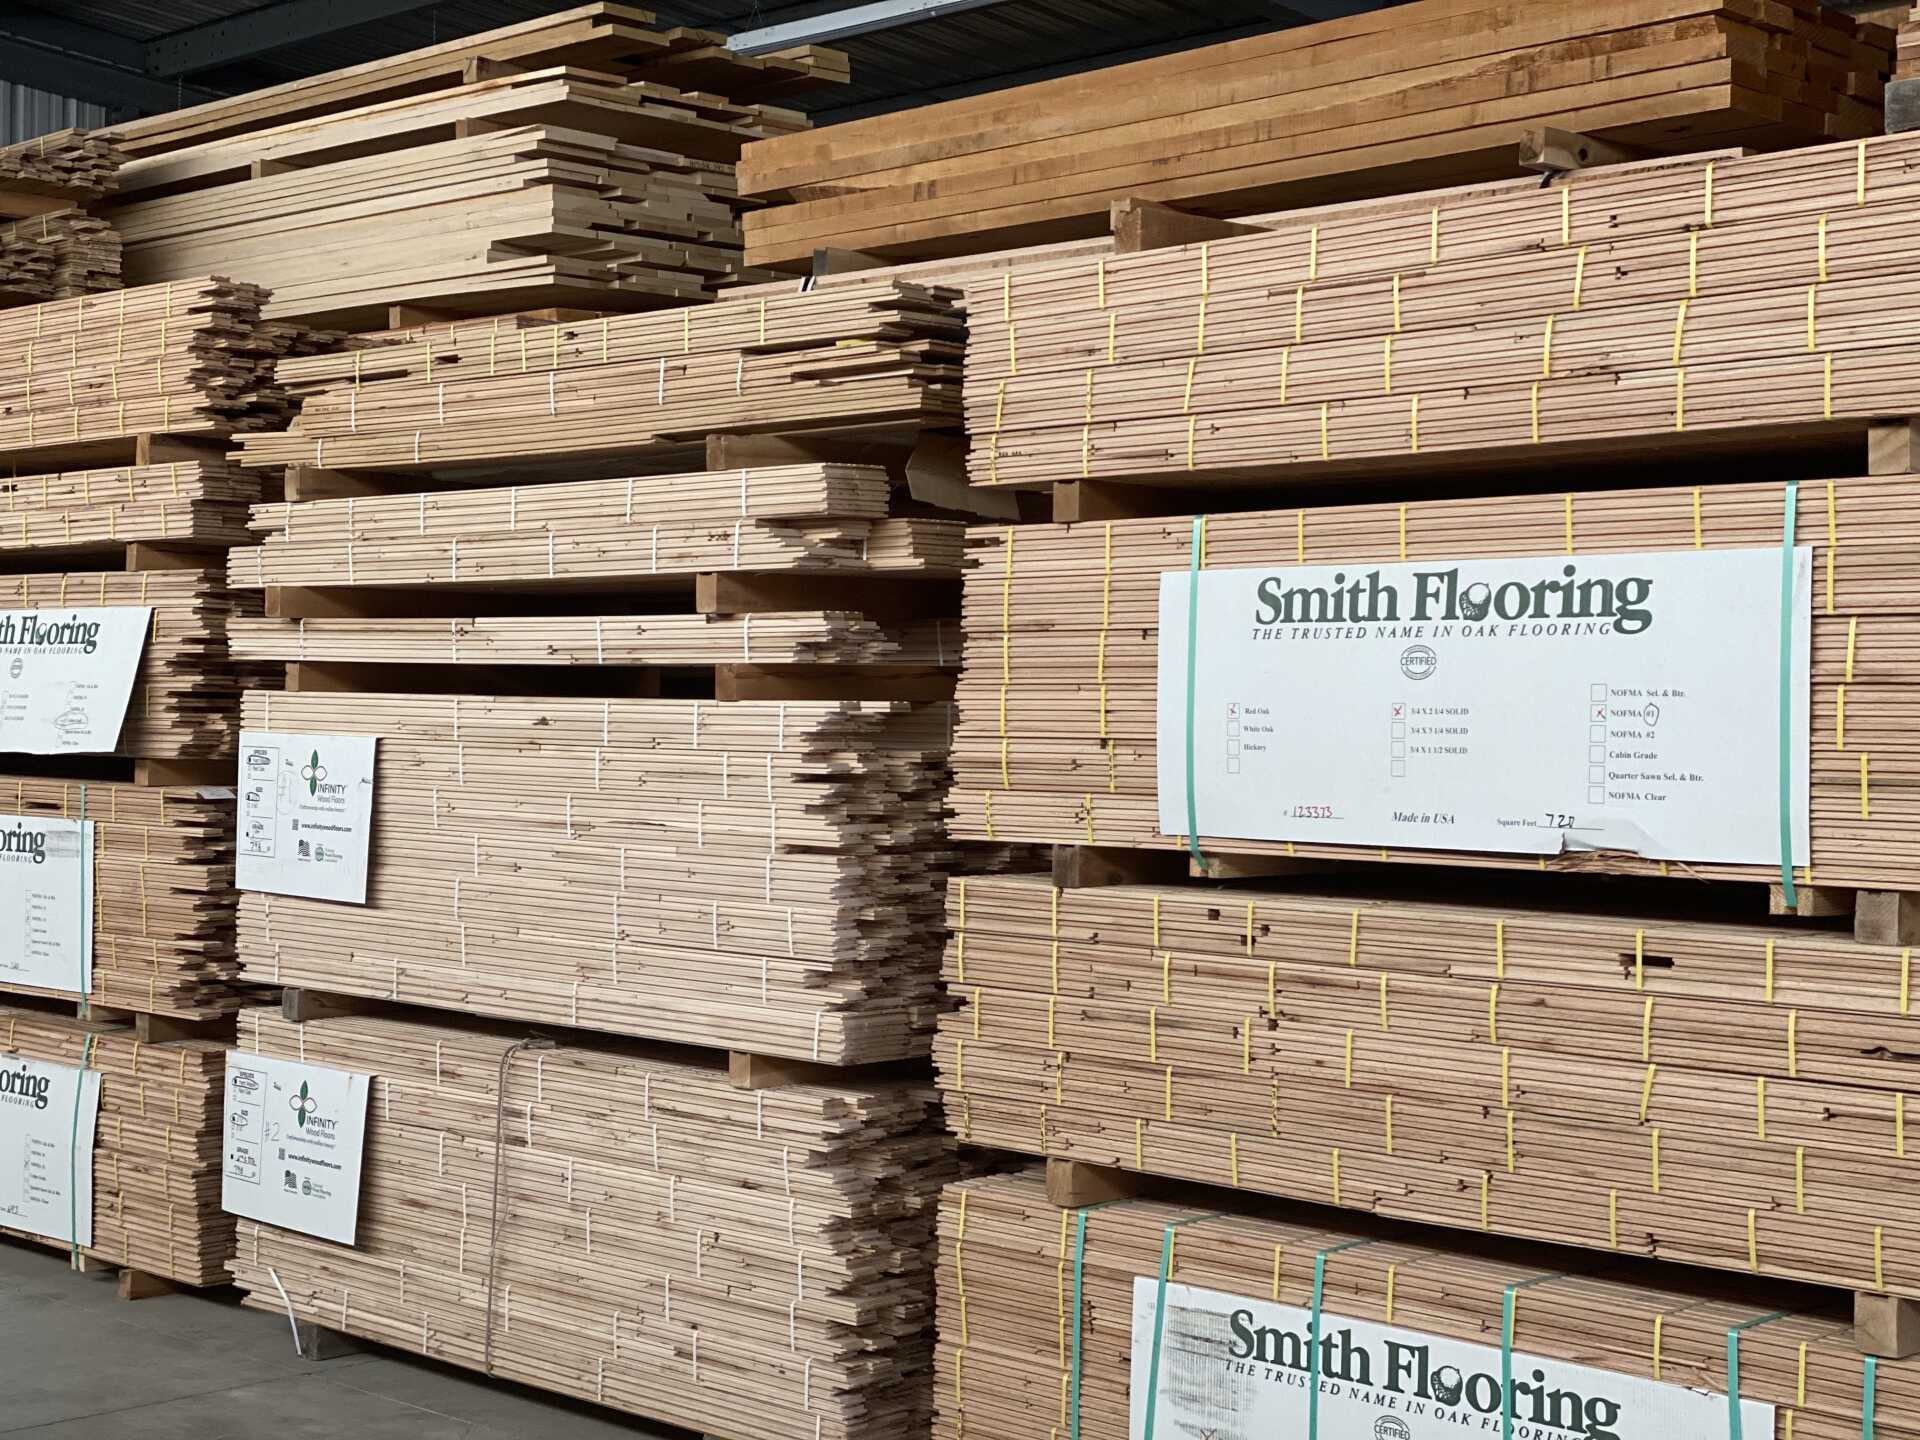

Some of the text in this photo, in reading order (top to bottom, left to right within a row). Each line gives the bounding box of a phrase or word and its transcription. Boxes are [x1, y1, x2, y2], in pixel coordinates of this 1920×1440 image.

[1255, 564, 1654, 635] Smith Flooring
[17, 613, 101, 654] Flooring
[1252, 621, 1612, 641] THE TRUSTED NAME IN OAK FLOORING
[1400, 656, 1437, 667] CERTIFIED
[1610, 688, 1643, 697] NOFMA
[1244, 706, 1270, 715] Red Oak
[1445, 707, 1470, 716] SOLID
[1610, 709, 1643, 719] NOFMA
[1444, 727, 1470, 736] SOLID
[1610, 730, 1643, 739] NOFMA
[1243, 743, 1267, 752] Hickory
[1444, 746, 1469, 755] SOLID
[1609, 750, 1659, 760] Cabin Grade
[1608, 771, 1639, 781] Quarter
[1640, 773, 1662, 781] Sawn
[1608, 791, 1668, 802] NOFMA Clear
[1393, 811, 1455, 825] Made in USA
[1496, 817, 1537, 828] Square Feet
[306, 1115, 337, 1130] INFINITY
[306, 1126, 320, 1137] Wood
[1224, 1358, 1256, 1377] THE
[1263, 1368, 1341, 1396] TRUSED
[1349, 1387, 1397, 1410] NAME
[1405, 1399, 1426, 1416] IN
[1434, 1406, 1473, 1426] OAK
